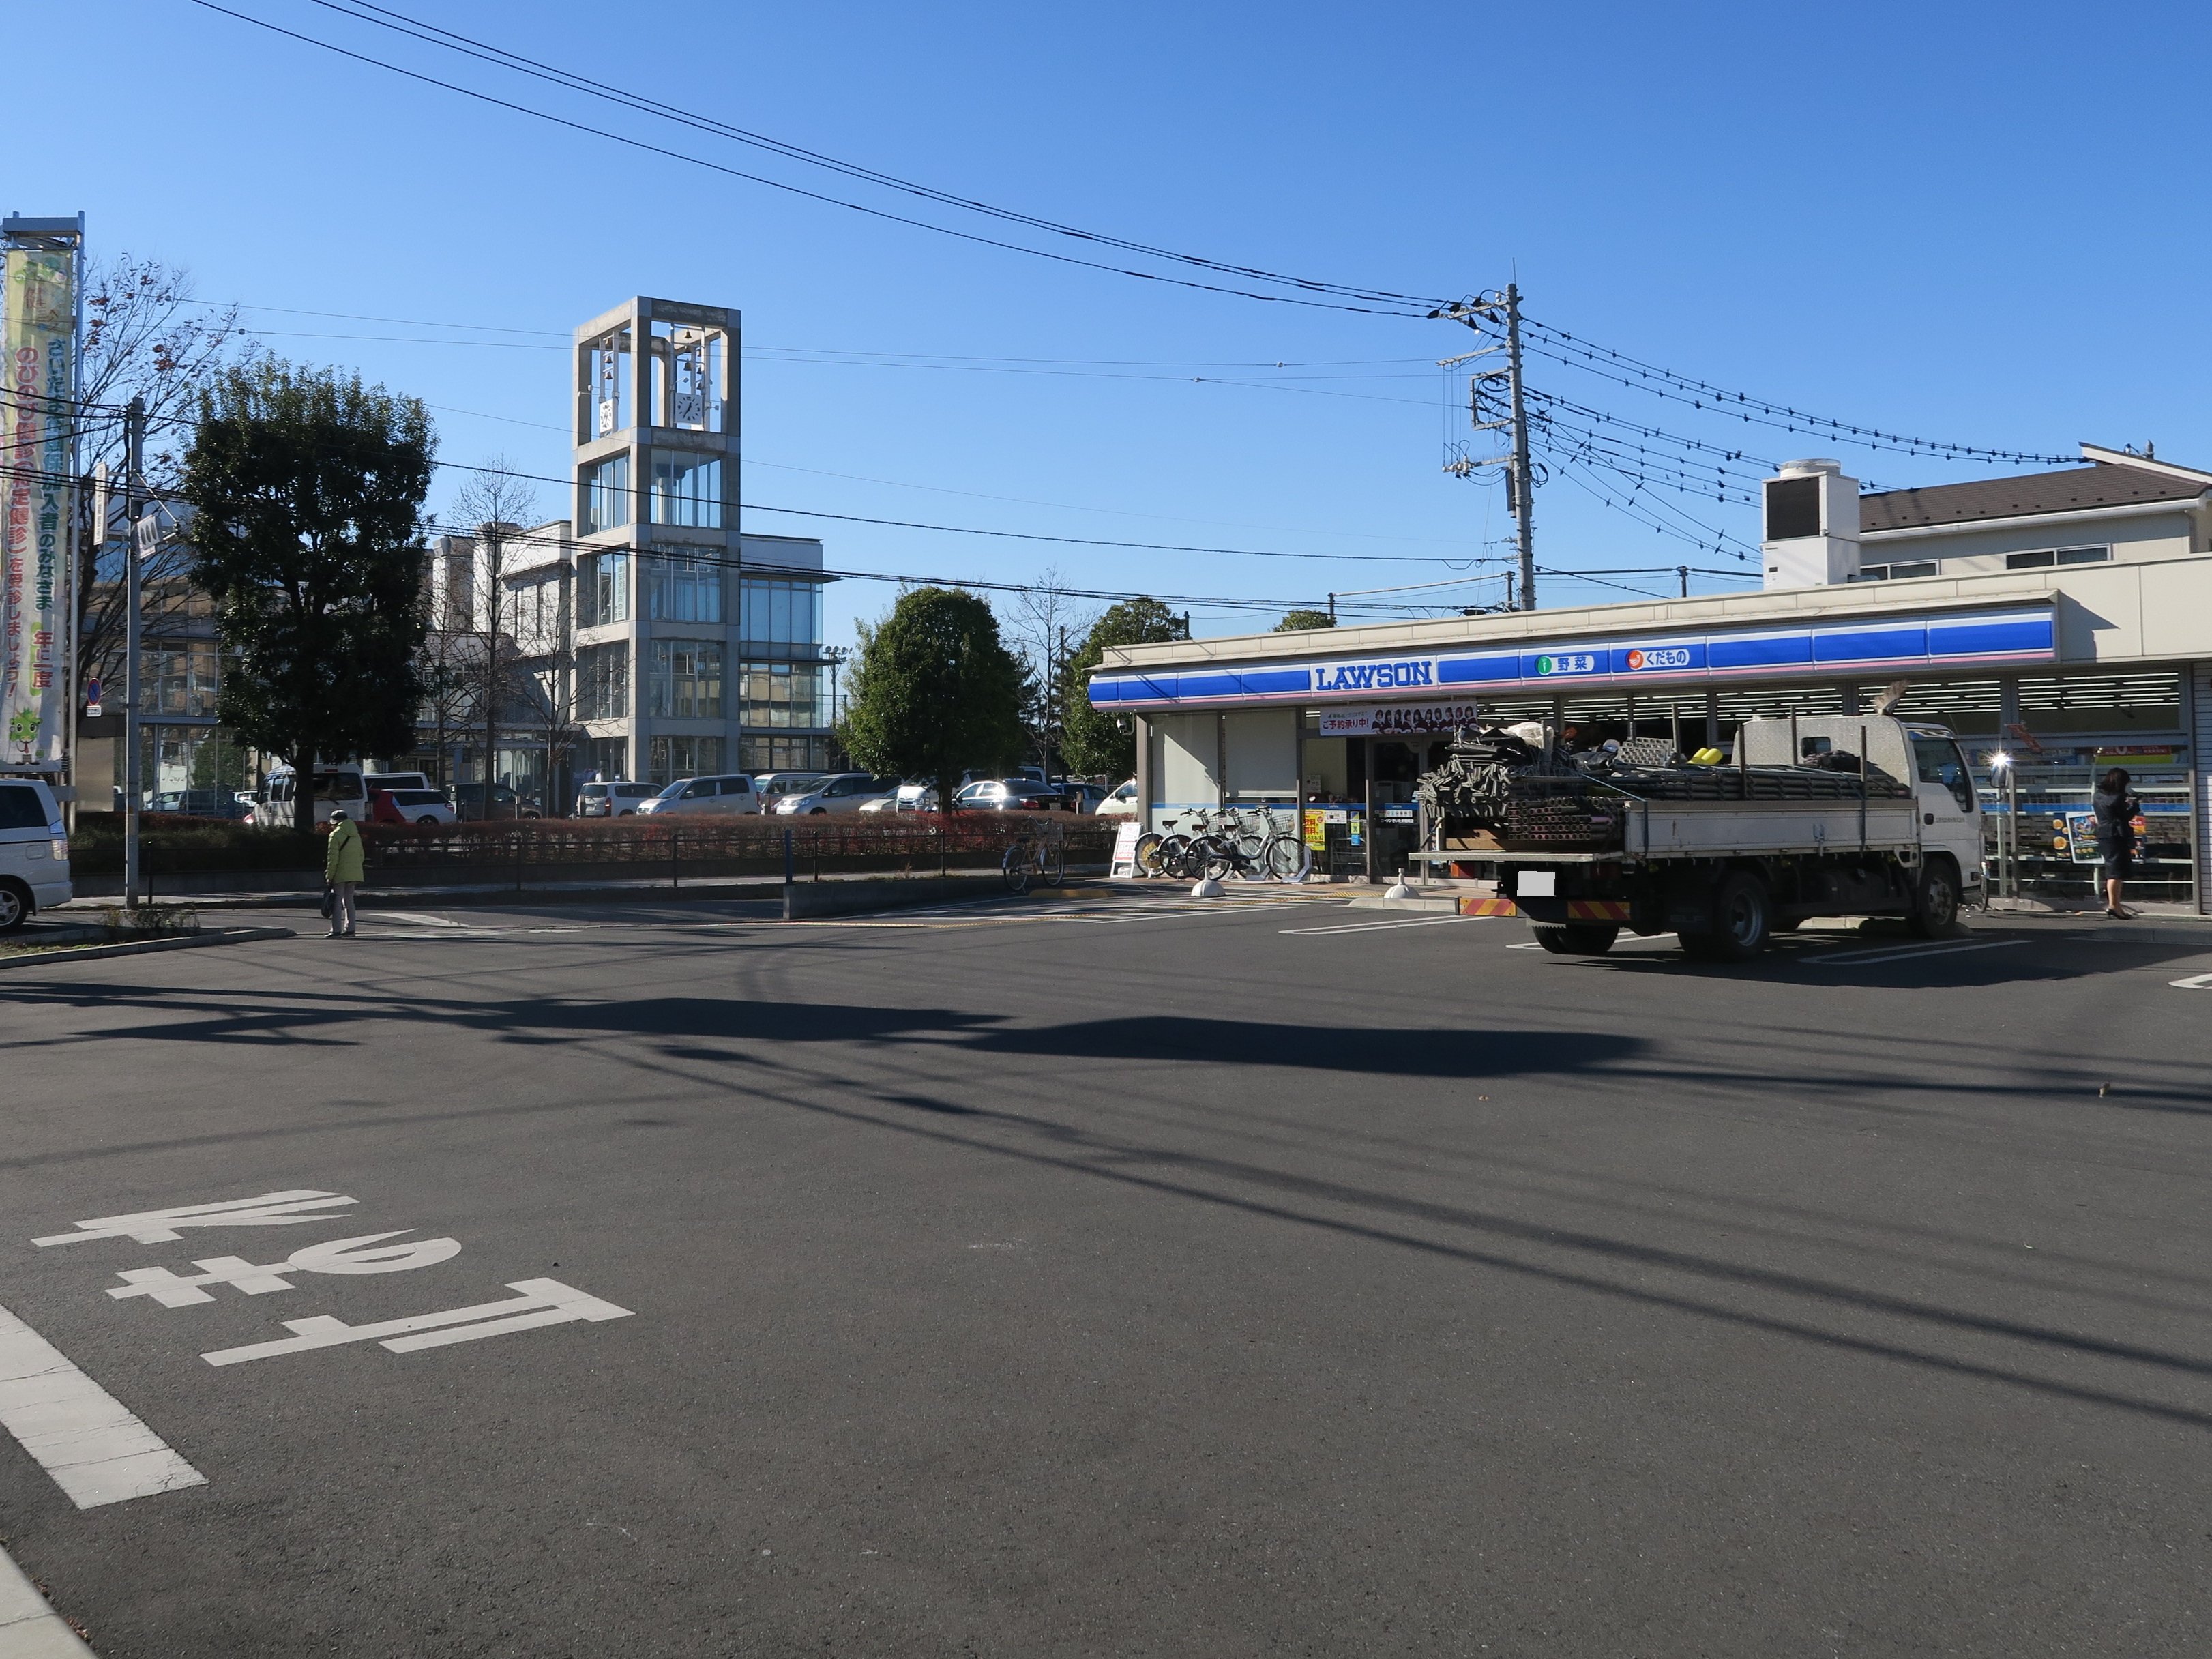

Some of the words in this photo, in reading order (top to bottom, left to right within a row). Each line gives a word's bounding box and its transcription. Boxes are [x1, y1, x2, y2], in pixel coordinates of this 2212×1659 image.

[32, 630, 54, 688] 年に一度
[1557, 655, 1588, 671] 野菜
[1646, 649, 1687, 666] くだもの
[1316, 660, 1432, 691] LAWSON
[1322, 718, 1370, 730] ご予約承り中!
